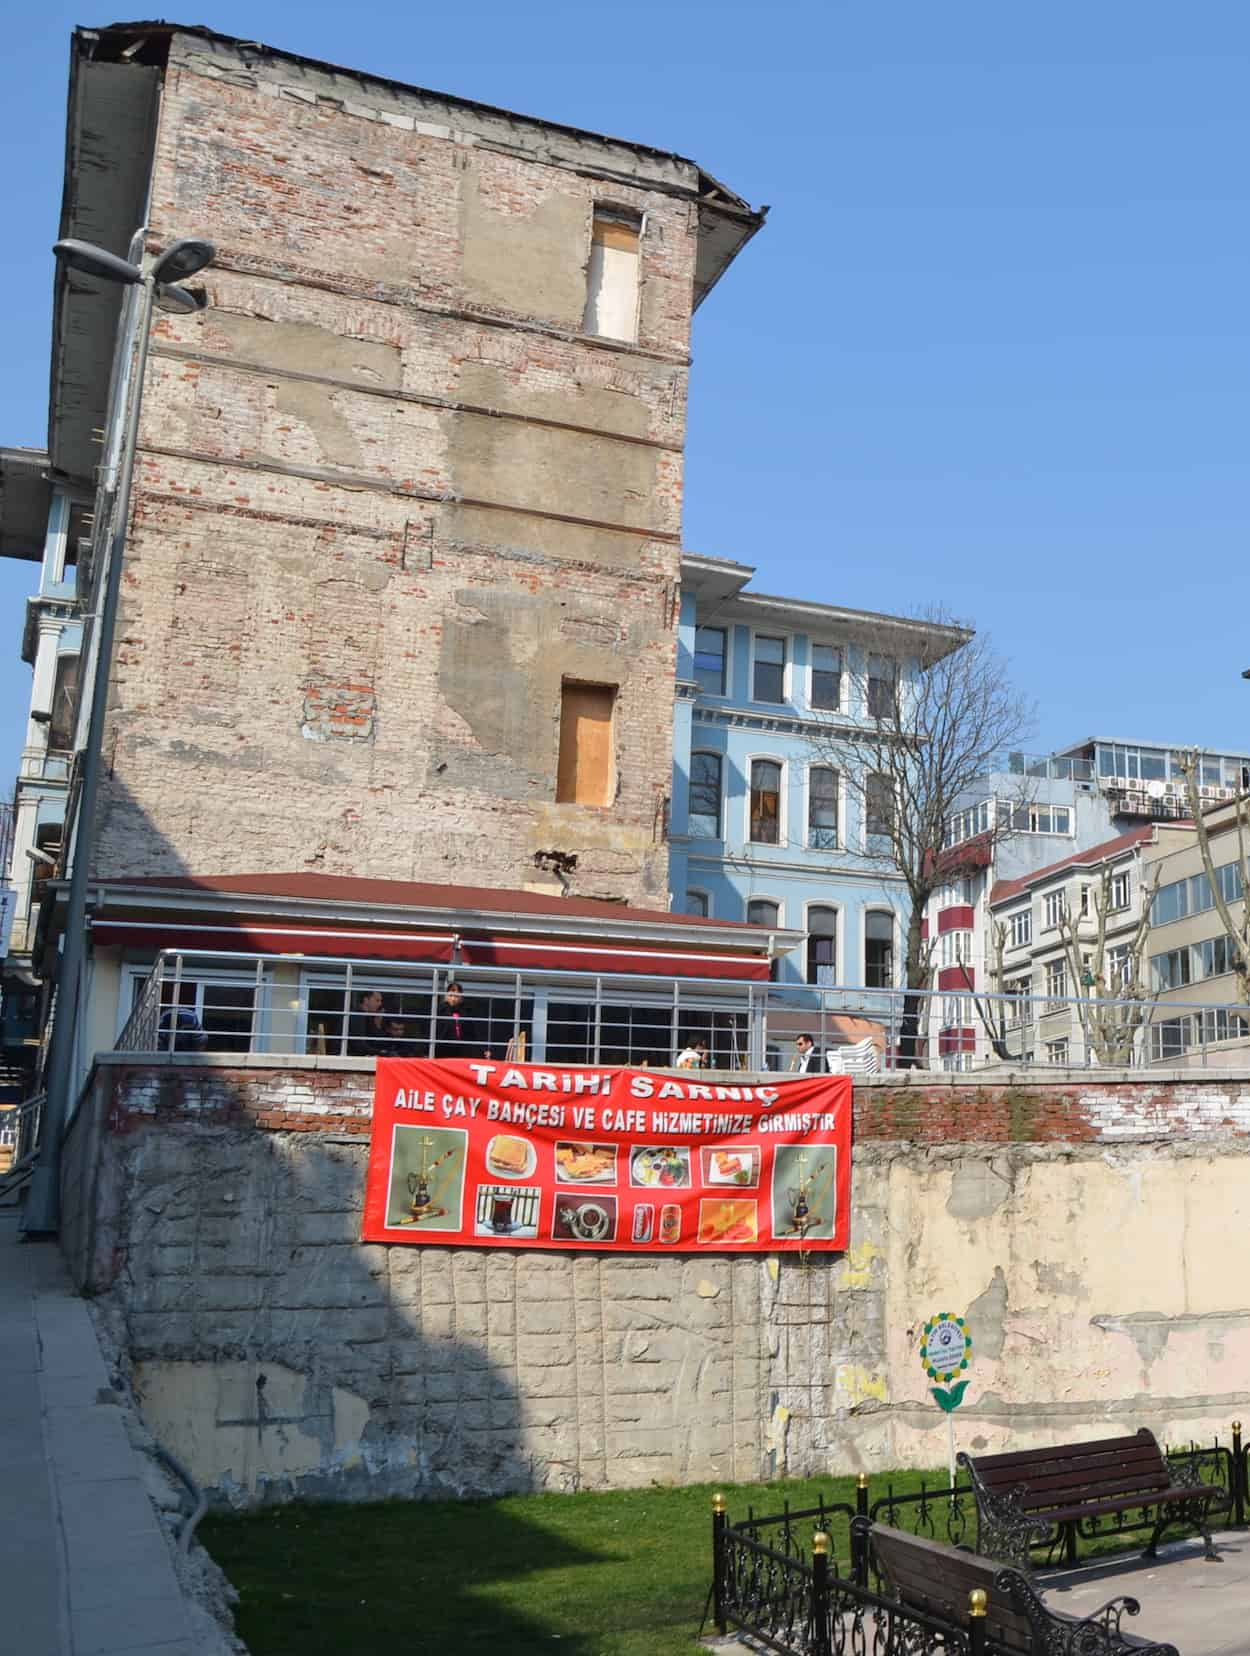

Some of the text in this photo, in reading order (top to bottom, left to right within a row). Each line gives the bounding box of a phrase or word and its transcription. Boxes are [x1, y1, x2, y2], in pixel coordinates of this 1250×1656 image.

[442, 1094, 480, 1119] ÇAY
[572, 1107, 595, 1130] VE
[602, 1109, 647, 1133] CAFE
